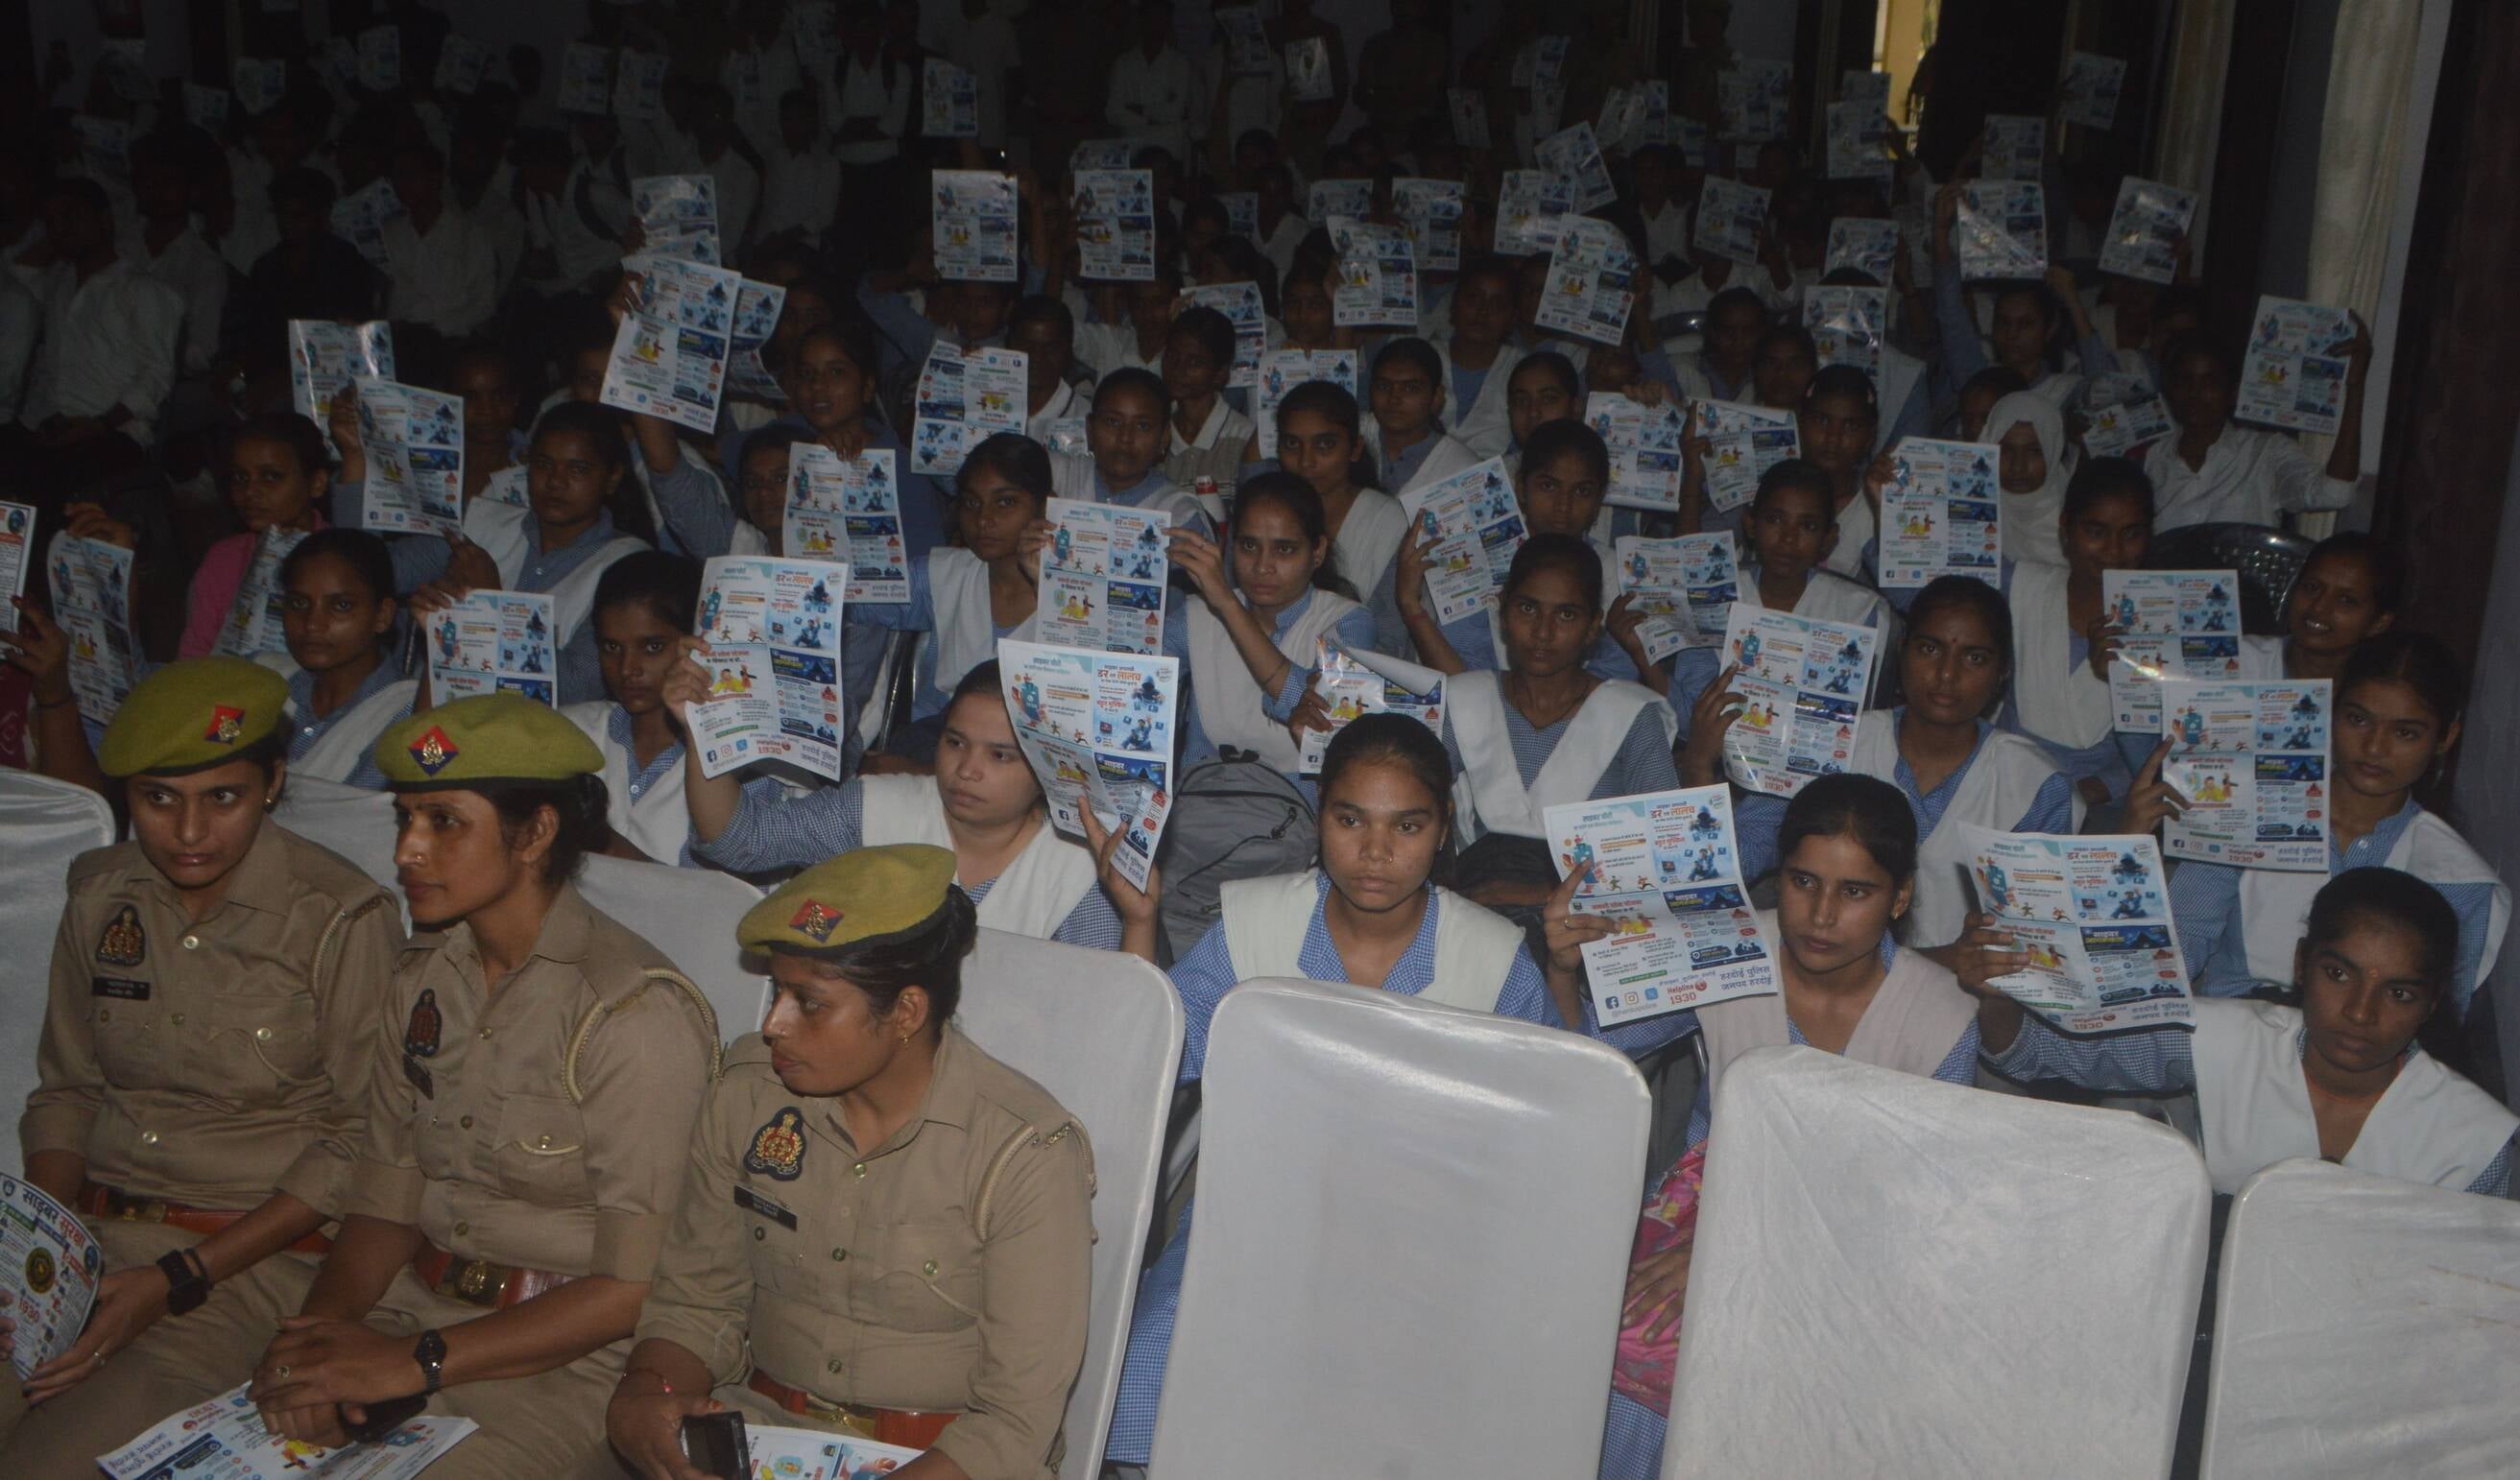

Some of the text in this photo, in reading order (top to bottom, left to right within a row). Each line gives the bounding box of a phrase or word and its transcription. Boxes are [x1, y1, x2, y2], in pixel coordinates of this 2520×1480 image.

[1720, 966, 1770, 981] हरदोई पुलिस
[1667, 984, 1694, 994] Helpline
[1721, 976, 1772, 991] जनपद हरदोई
[1670, 992, 1696, 1005] 1930
[22, 1188, 58, 1224] साइबर
[60, 1216, 86, 1249] सुरक्षा
[19, 1298, 40, 1323] 1930
